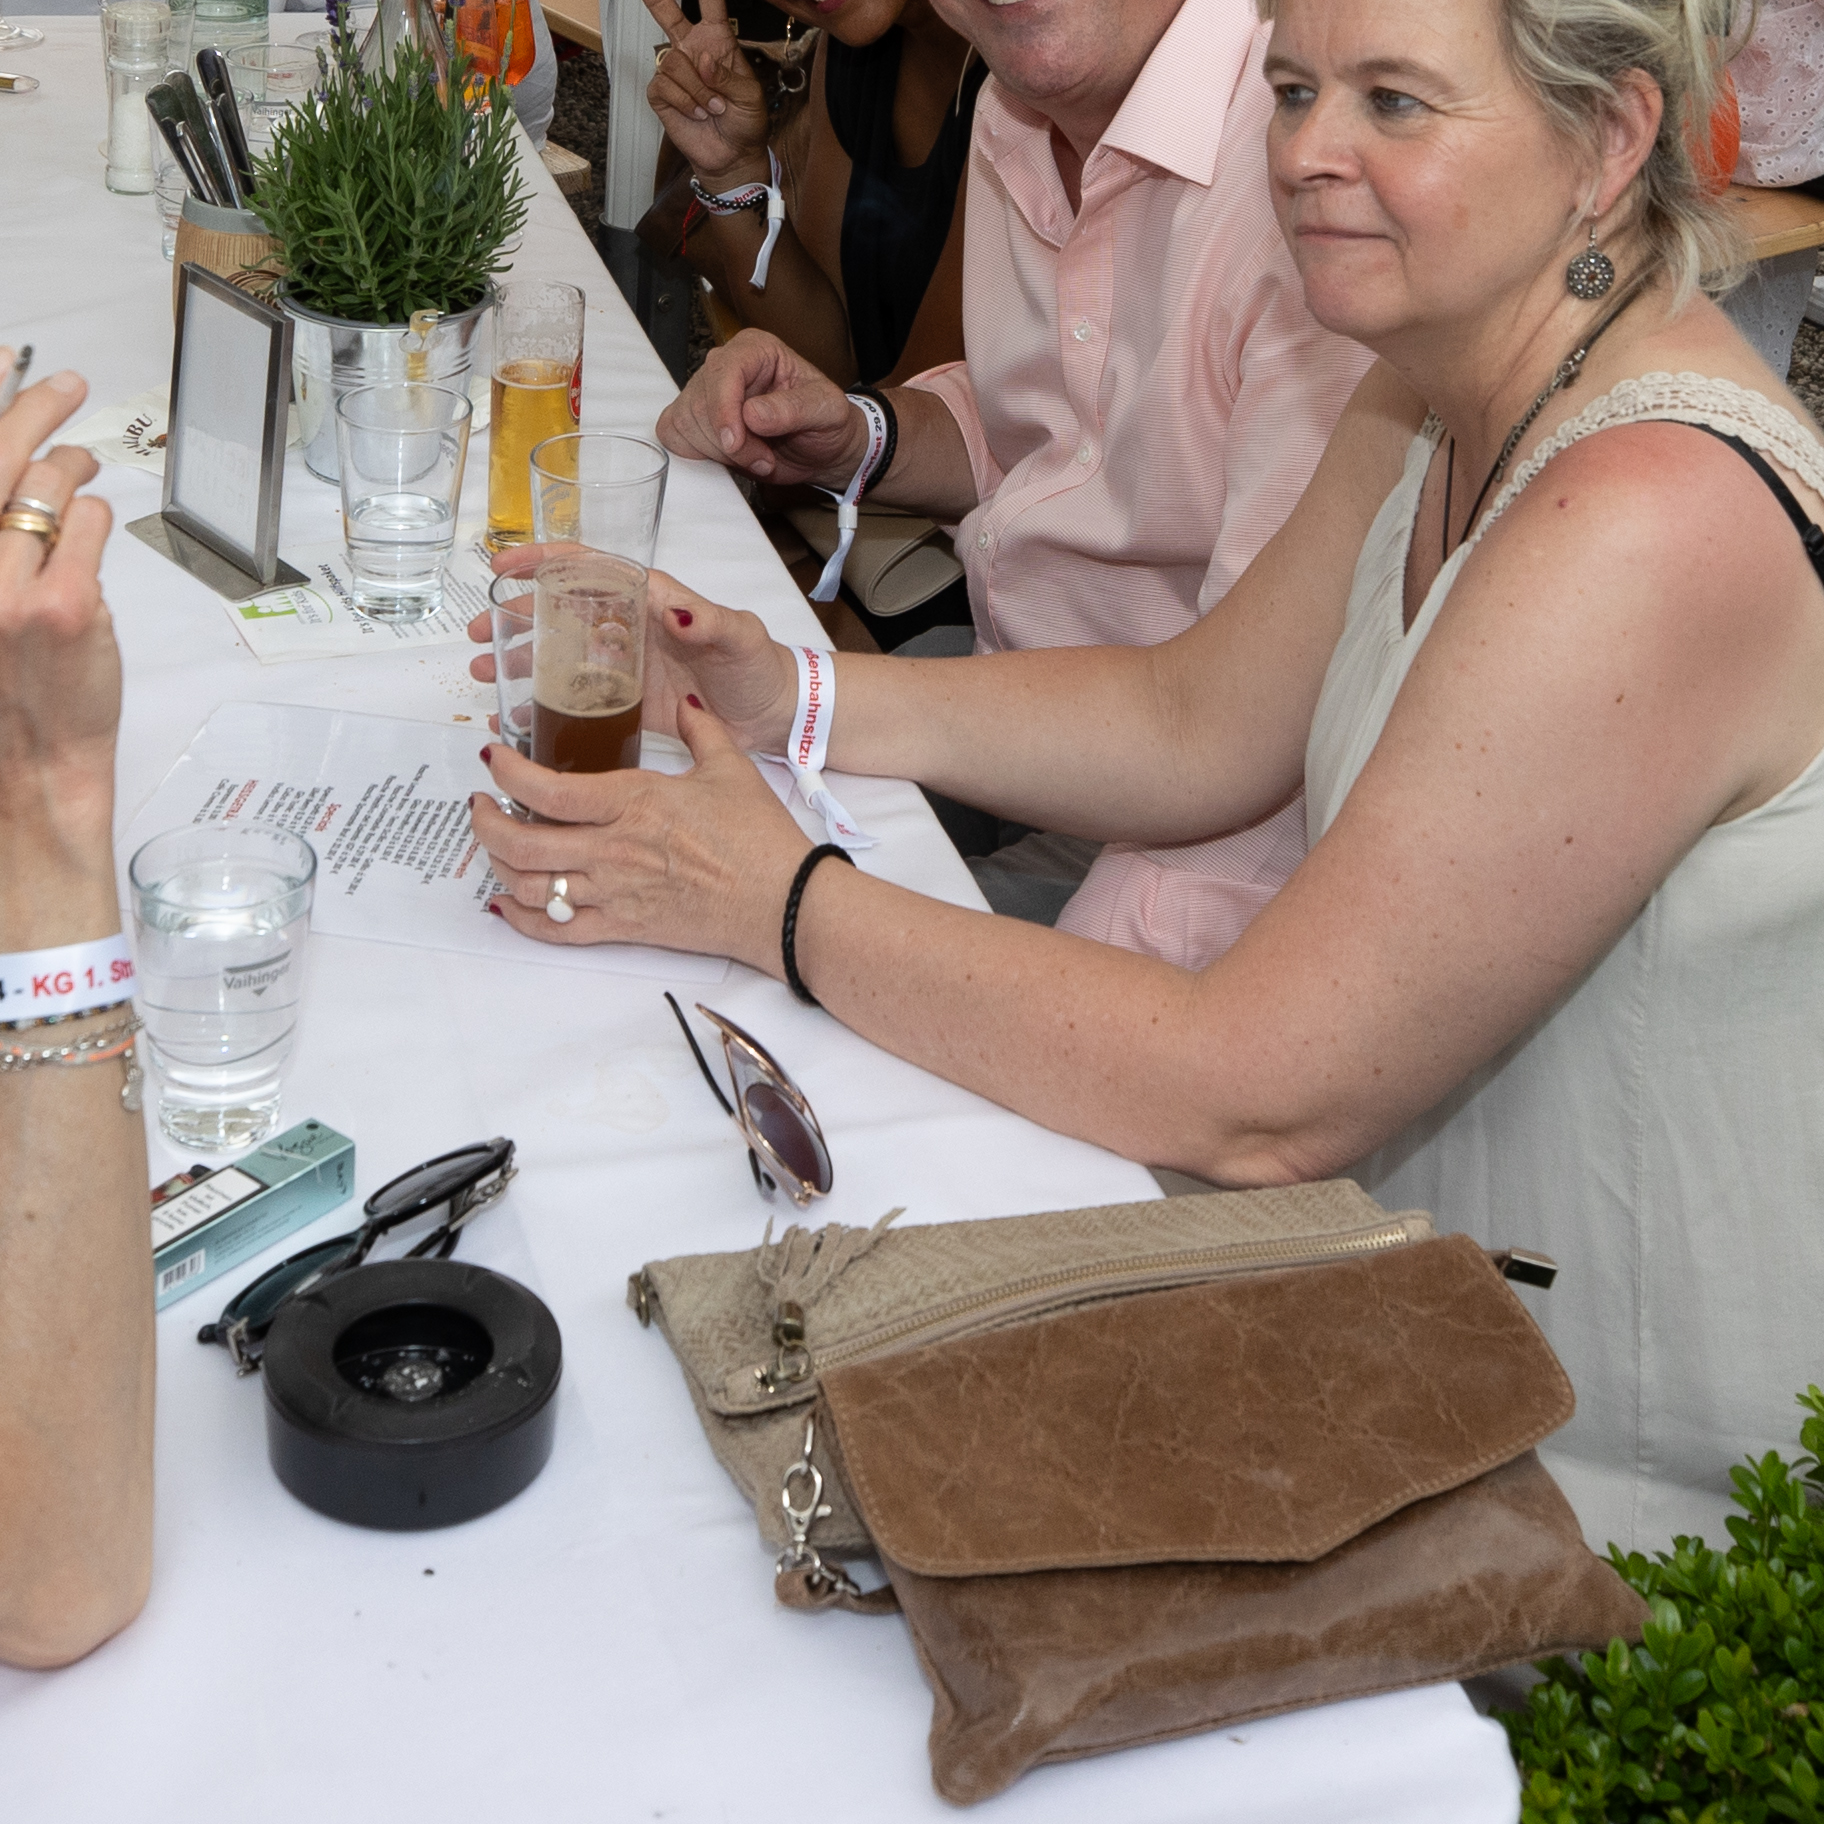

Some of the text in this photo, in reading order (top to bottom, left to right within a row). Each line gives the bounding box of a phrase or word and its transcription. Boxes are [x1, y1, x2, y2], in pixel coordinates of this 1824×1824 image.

[313, 802, 341, 832] Specials
[31, 971, 75, 999] KG
[83, 968, 104, 989] 1.
[223, 963, 294, 991] Vaihinger
